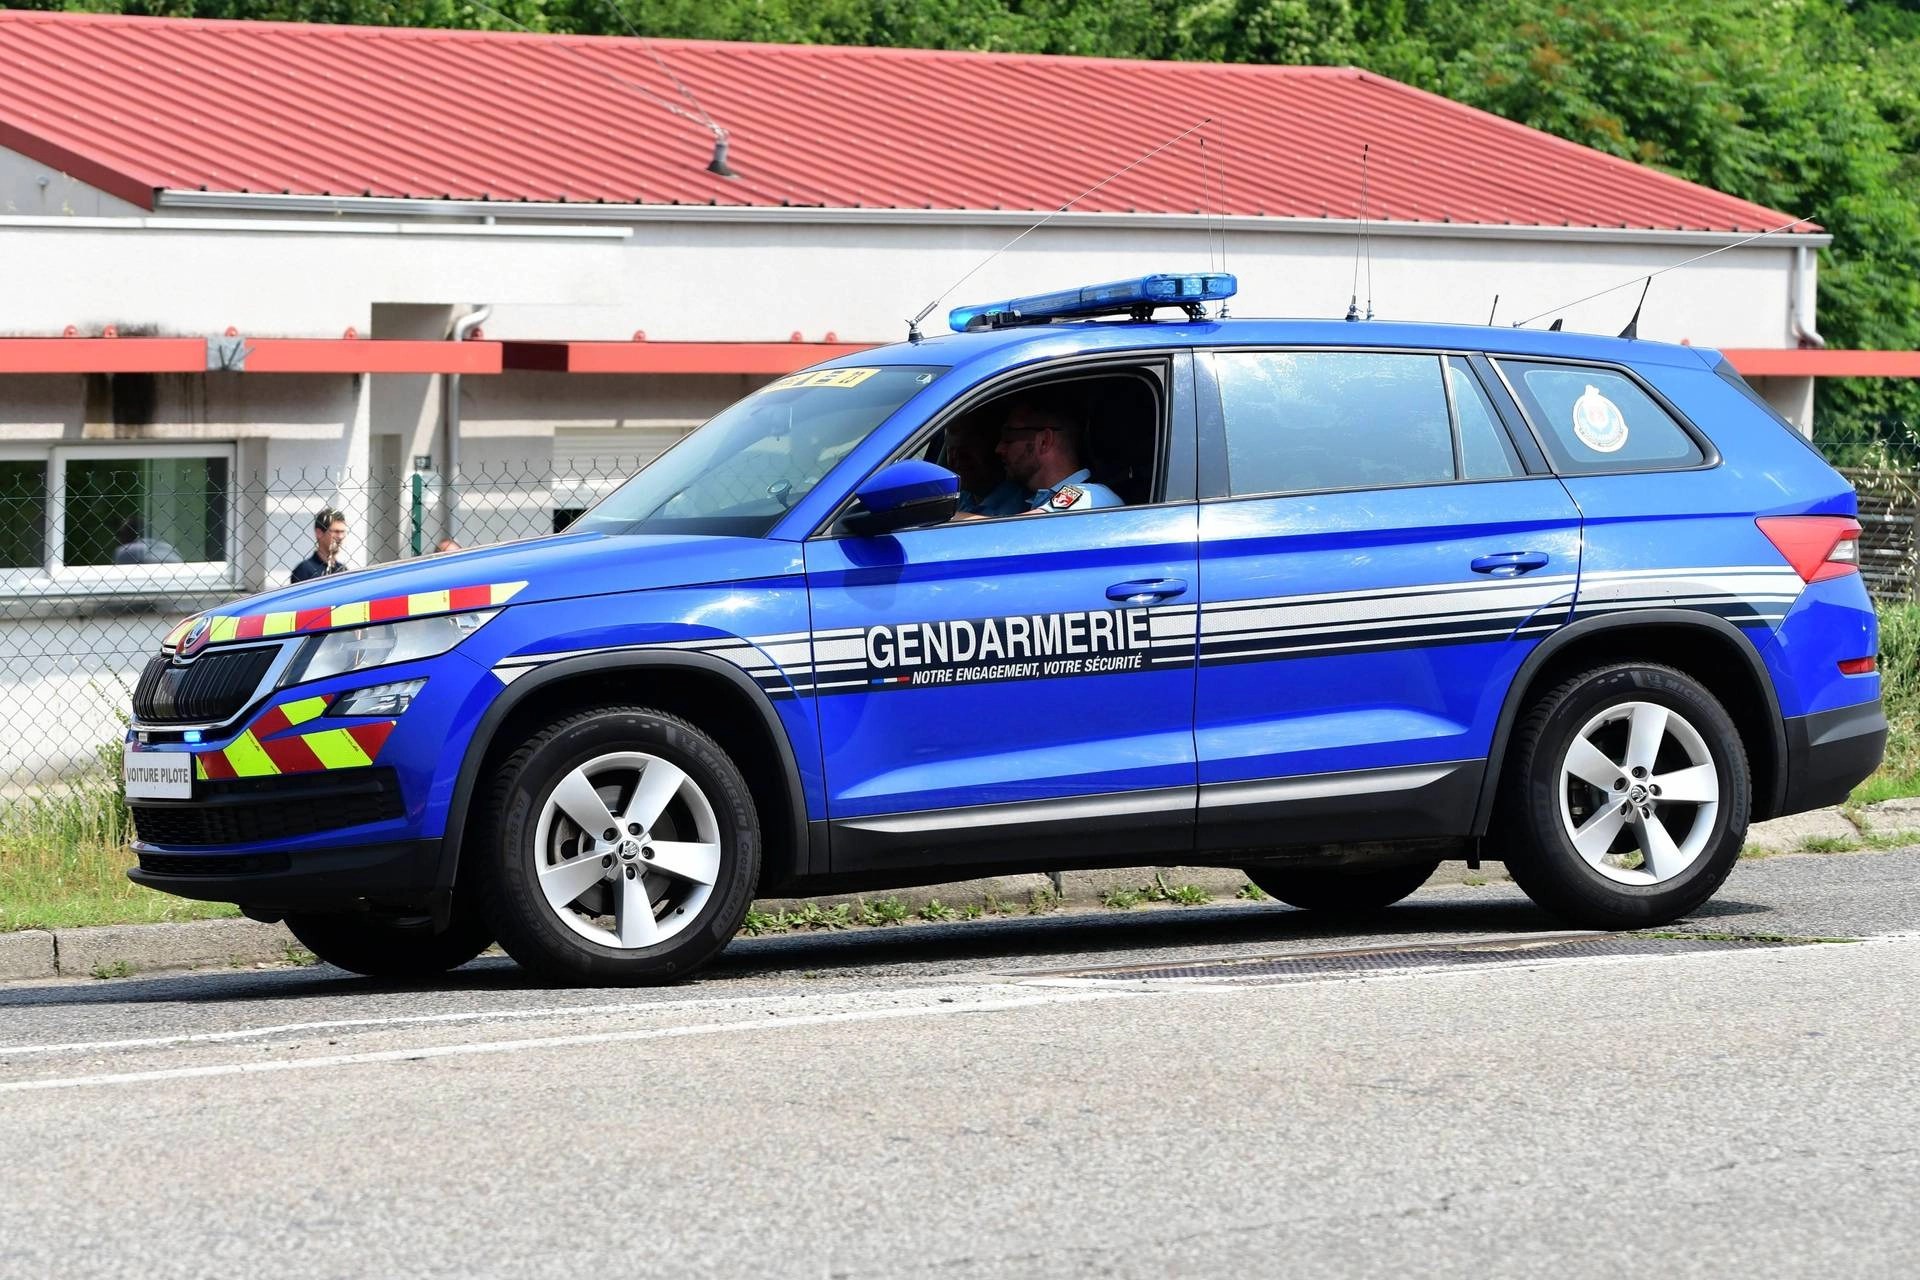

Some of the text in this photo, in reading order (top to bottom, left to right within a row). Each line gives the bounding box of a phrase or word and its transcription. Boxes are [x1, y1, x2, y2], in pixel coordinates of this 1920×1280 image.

[866, 607, 1150, 669] GENDARMERIE
[912, 652, 1143, 685] NOTRE ENGAGEMENT, VOTRE SÉCURITÉ
[127, 767, 188, 784] VOITURE PILOTE
[698, 749, 748, 828] MICHELIN
